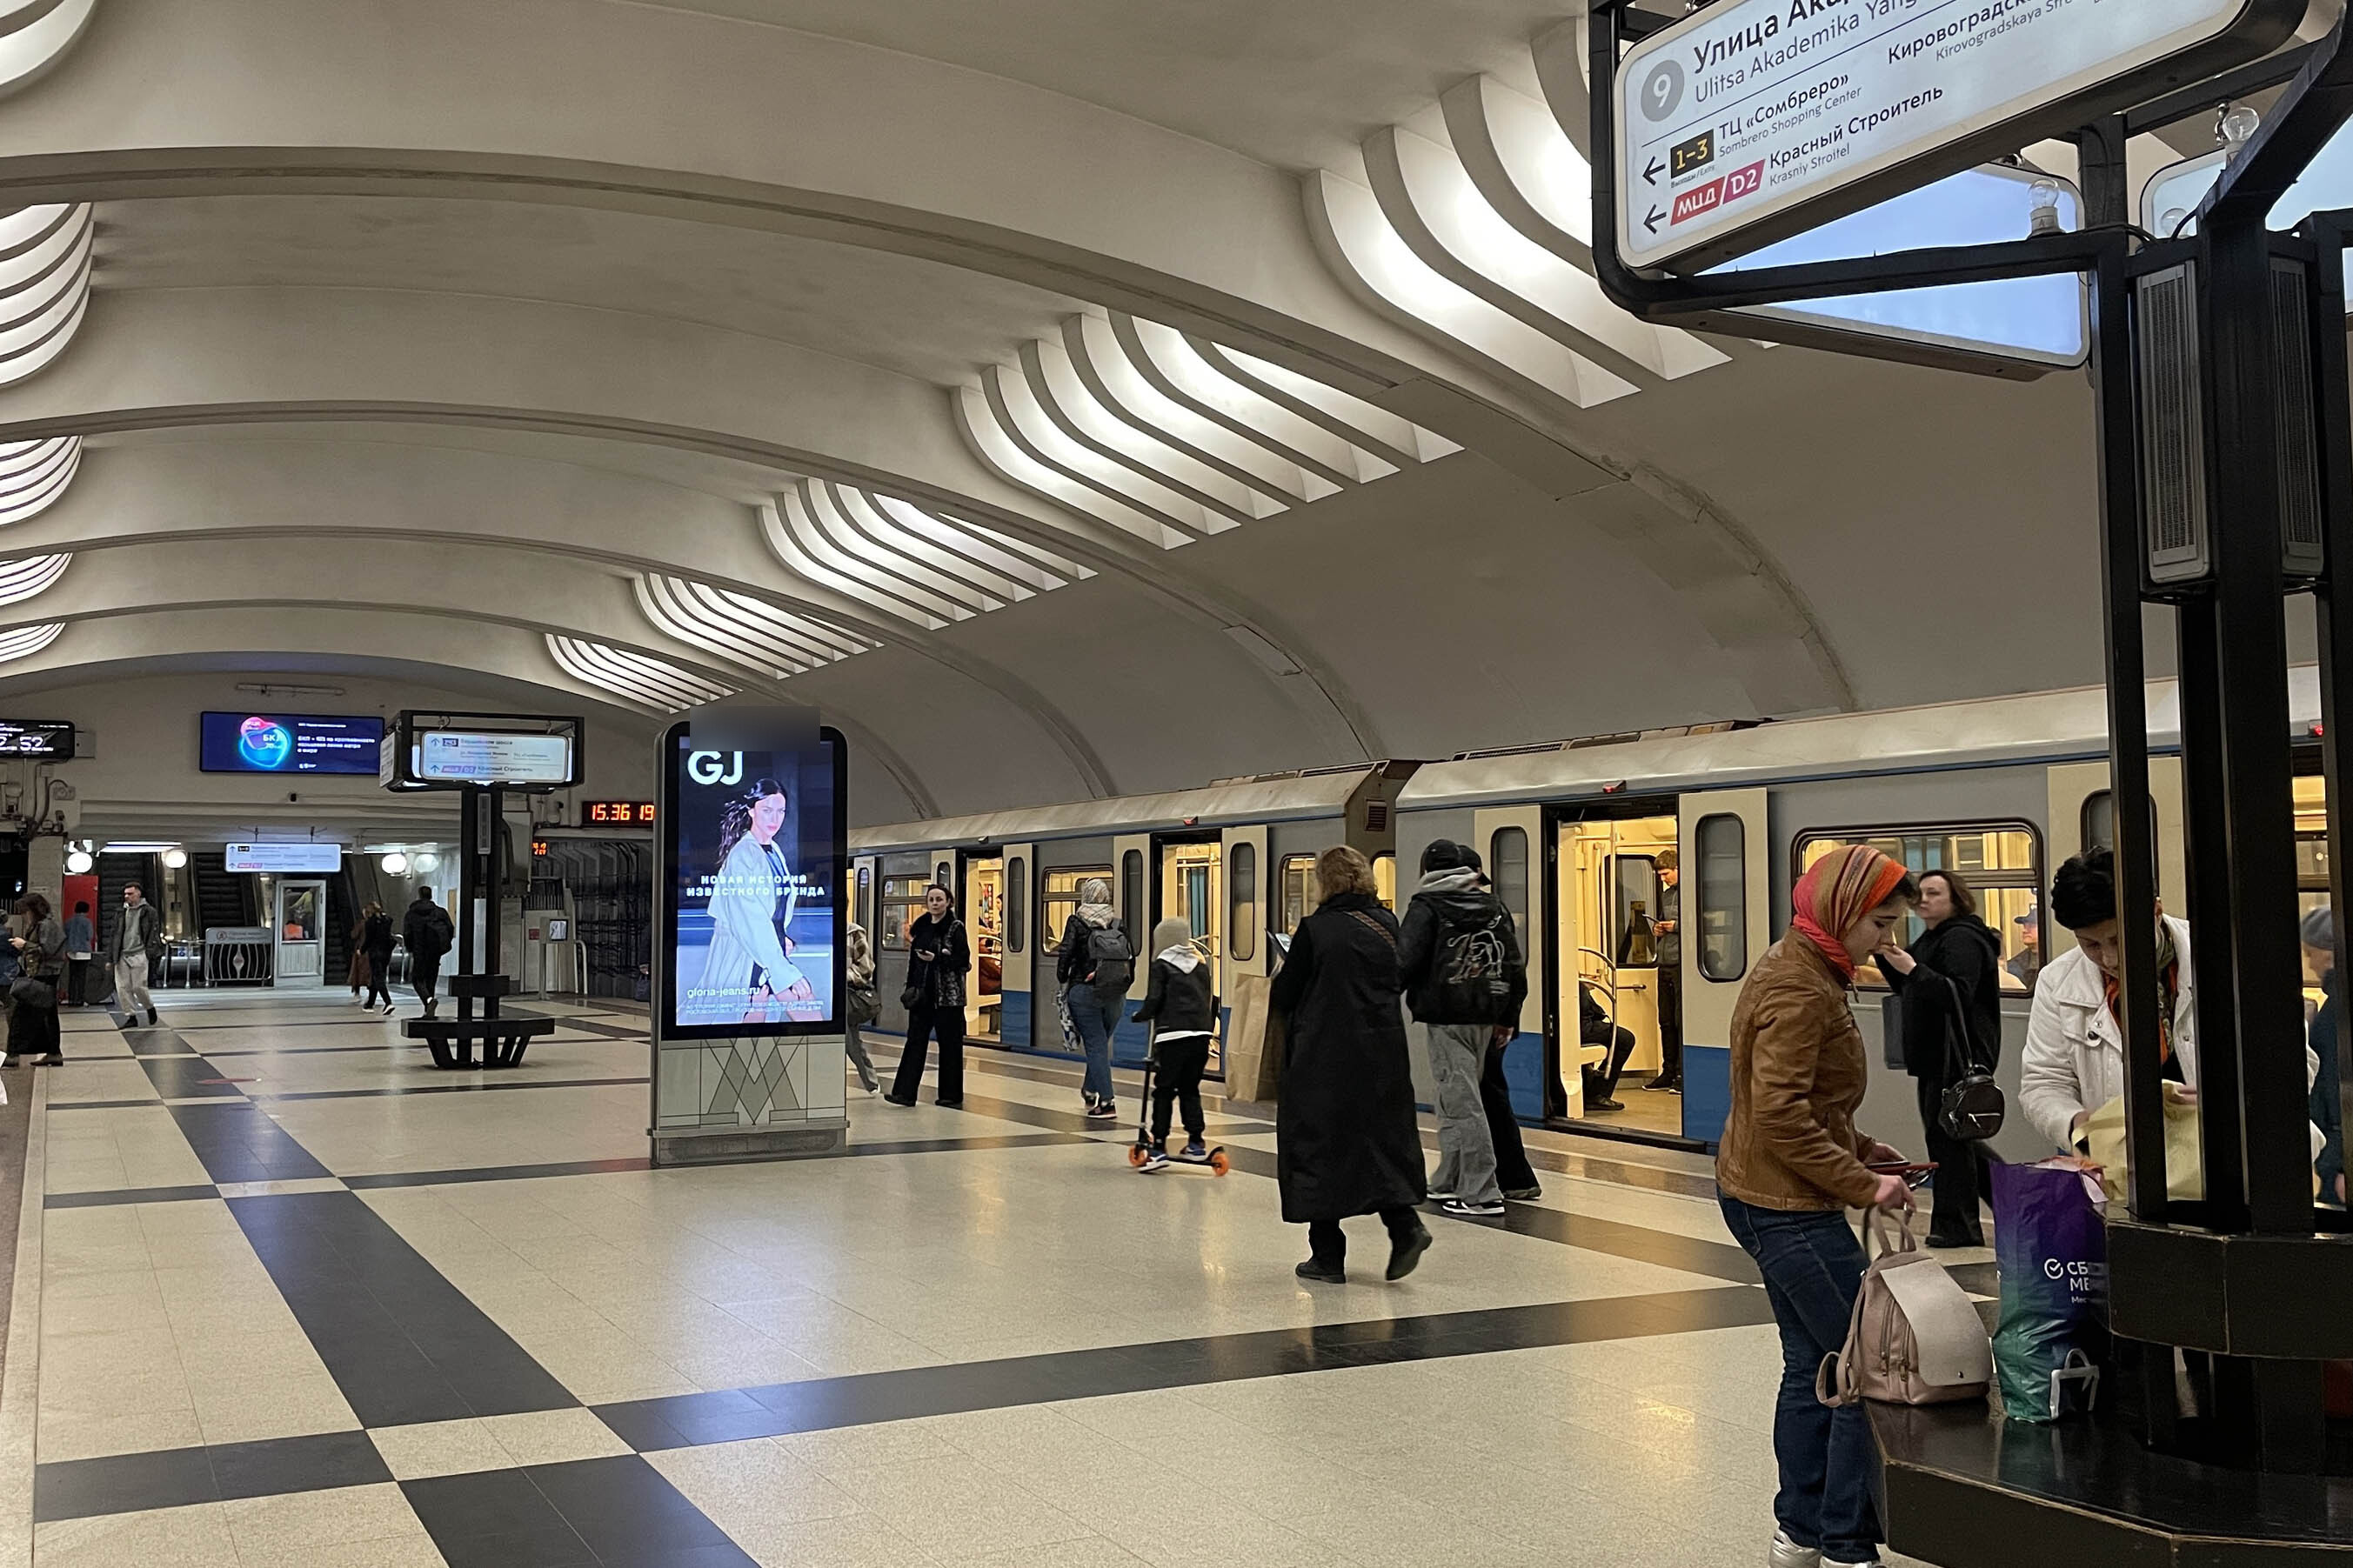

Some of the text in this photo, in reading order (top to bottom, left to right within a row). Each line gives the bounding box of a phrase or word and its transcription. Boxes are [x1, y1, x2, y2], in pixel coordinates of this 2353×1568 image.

[1694, 13, 1779, 74] Улица
[1936, 7, 2042, 62] Kirovogradskaya
[1696, 70, 1744, 103] Ulitsa
[1750, 13, 1860, 78] Akademika
[1653, 73, 1671, 109] 9
[1719, 74, 1848, 140] ТЦ «Сомбреро»
[1719, 85, 1862, 157] Sombrero Shopping Center
[1770, 87, 1943, 169] Красный Строитель
[1732, 169, 1757, 195] D2
[1770, 143, 1850, 187] Krasniy Stroitel
[19, 737, 43, 751] 52
[687, 751, 743, 785] GJ
[685, 885, 826, 897] ИЗВЕСТНОГО БРЕНДА
[700, 874, 807, 884] НОВАЯ ИСТОРИЯ
